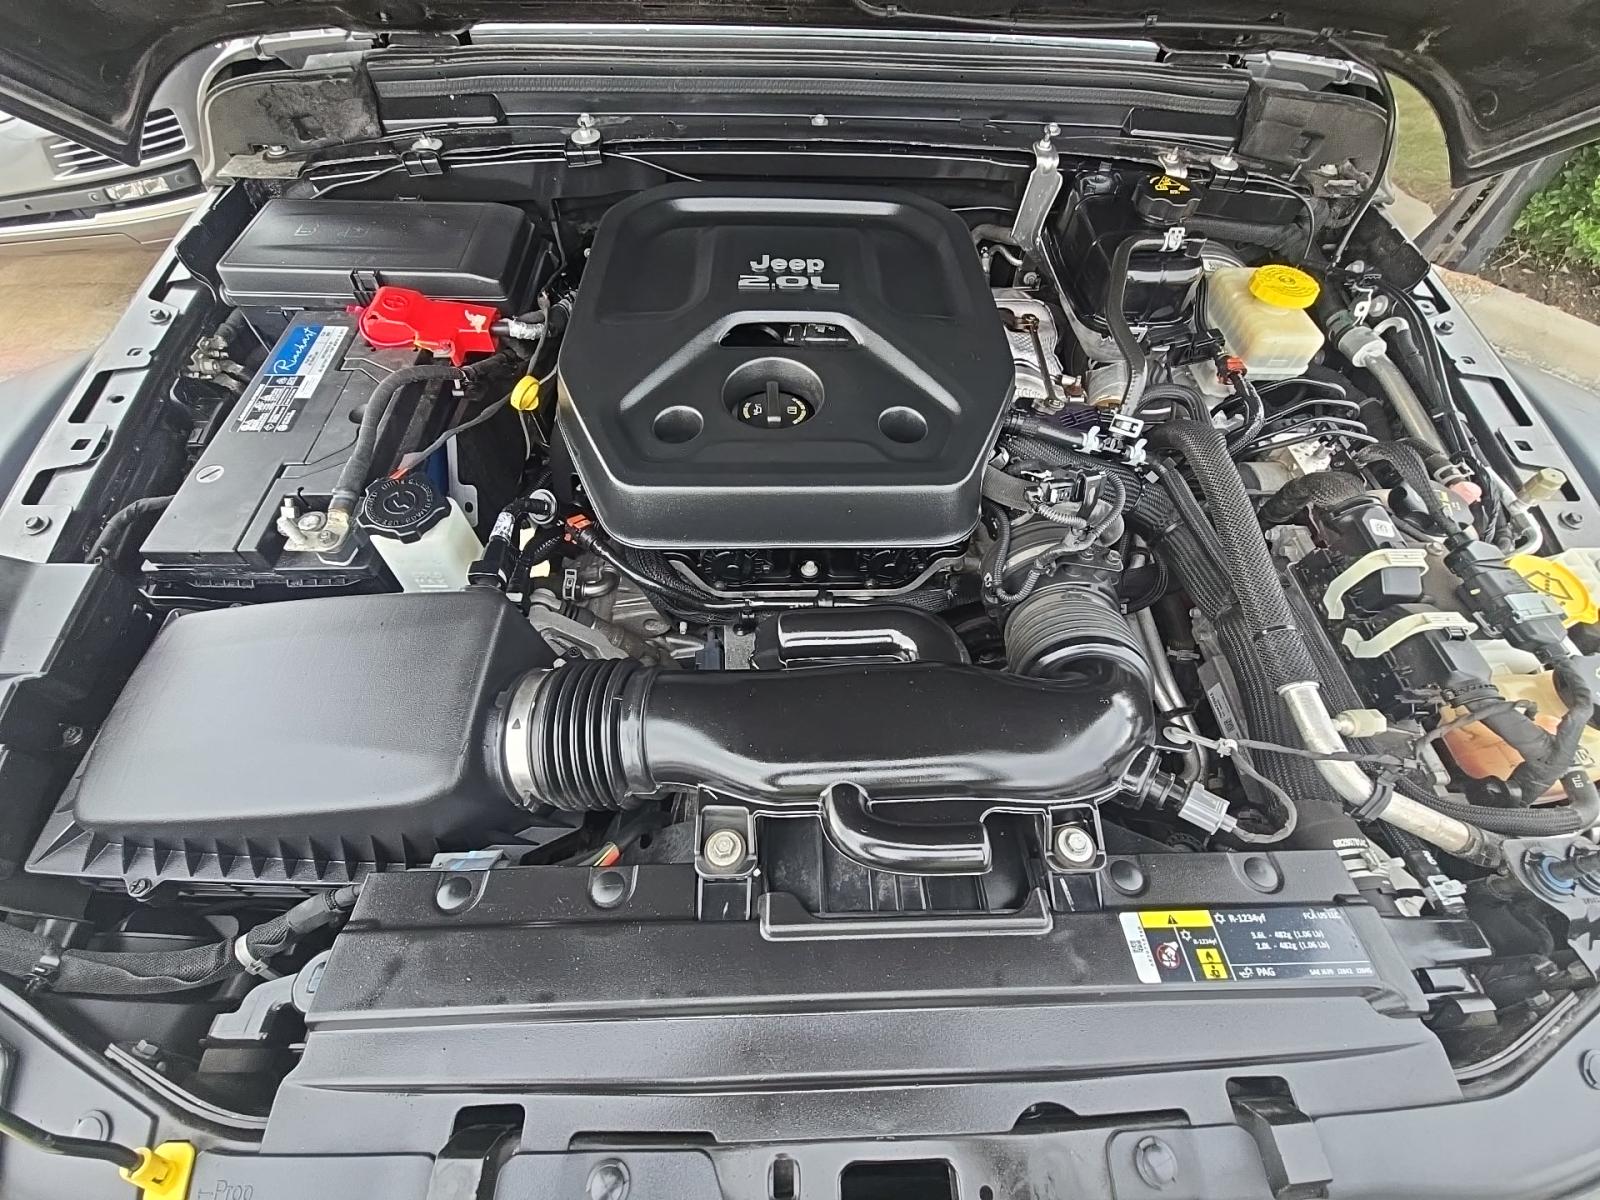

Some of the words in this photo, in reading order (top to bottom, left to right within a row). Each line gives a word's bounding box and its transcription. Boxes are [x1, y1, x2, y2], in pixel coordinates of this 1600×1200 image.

[750, 254, 825, 273] Jeep
[737, 274, 840, 291] 2.0L
[1228, 912, 1267, 924] R-1234yf
[1250, 931, 1267, 940] 3.6L
[1255, 942, 1272, 950] 2.0L
[1256, 967, 1276, 977] PAG
